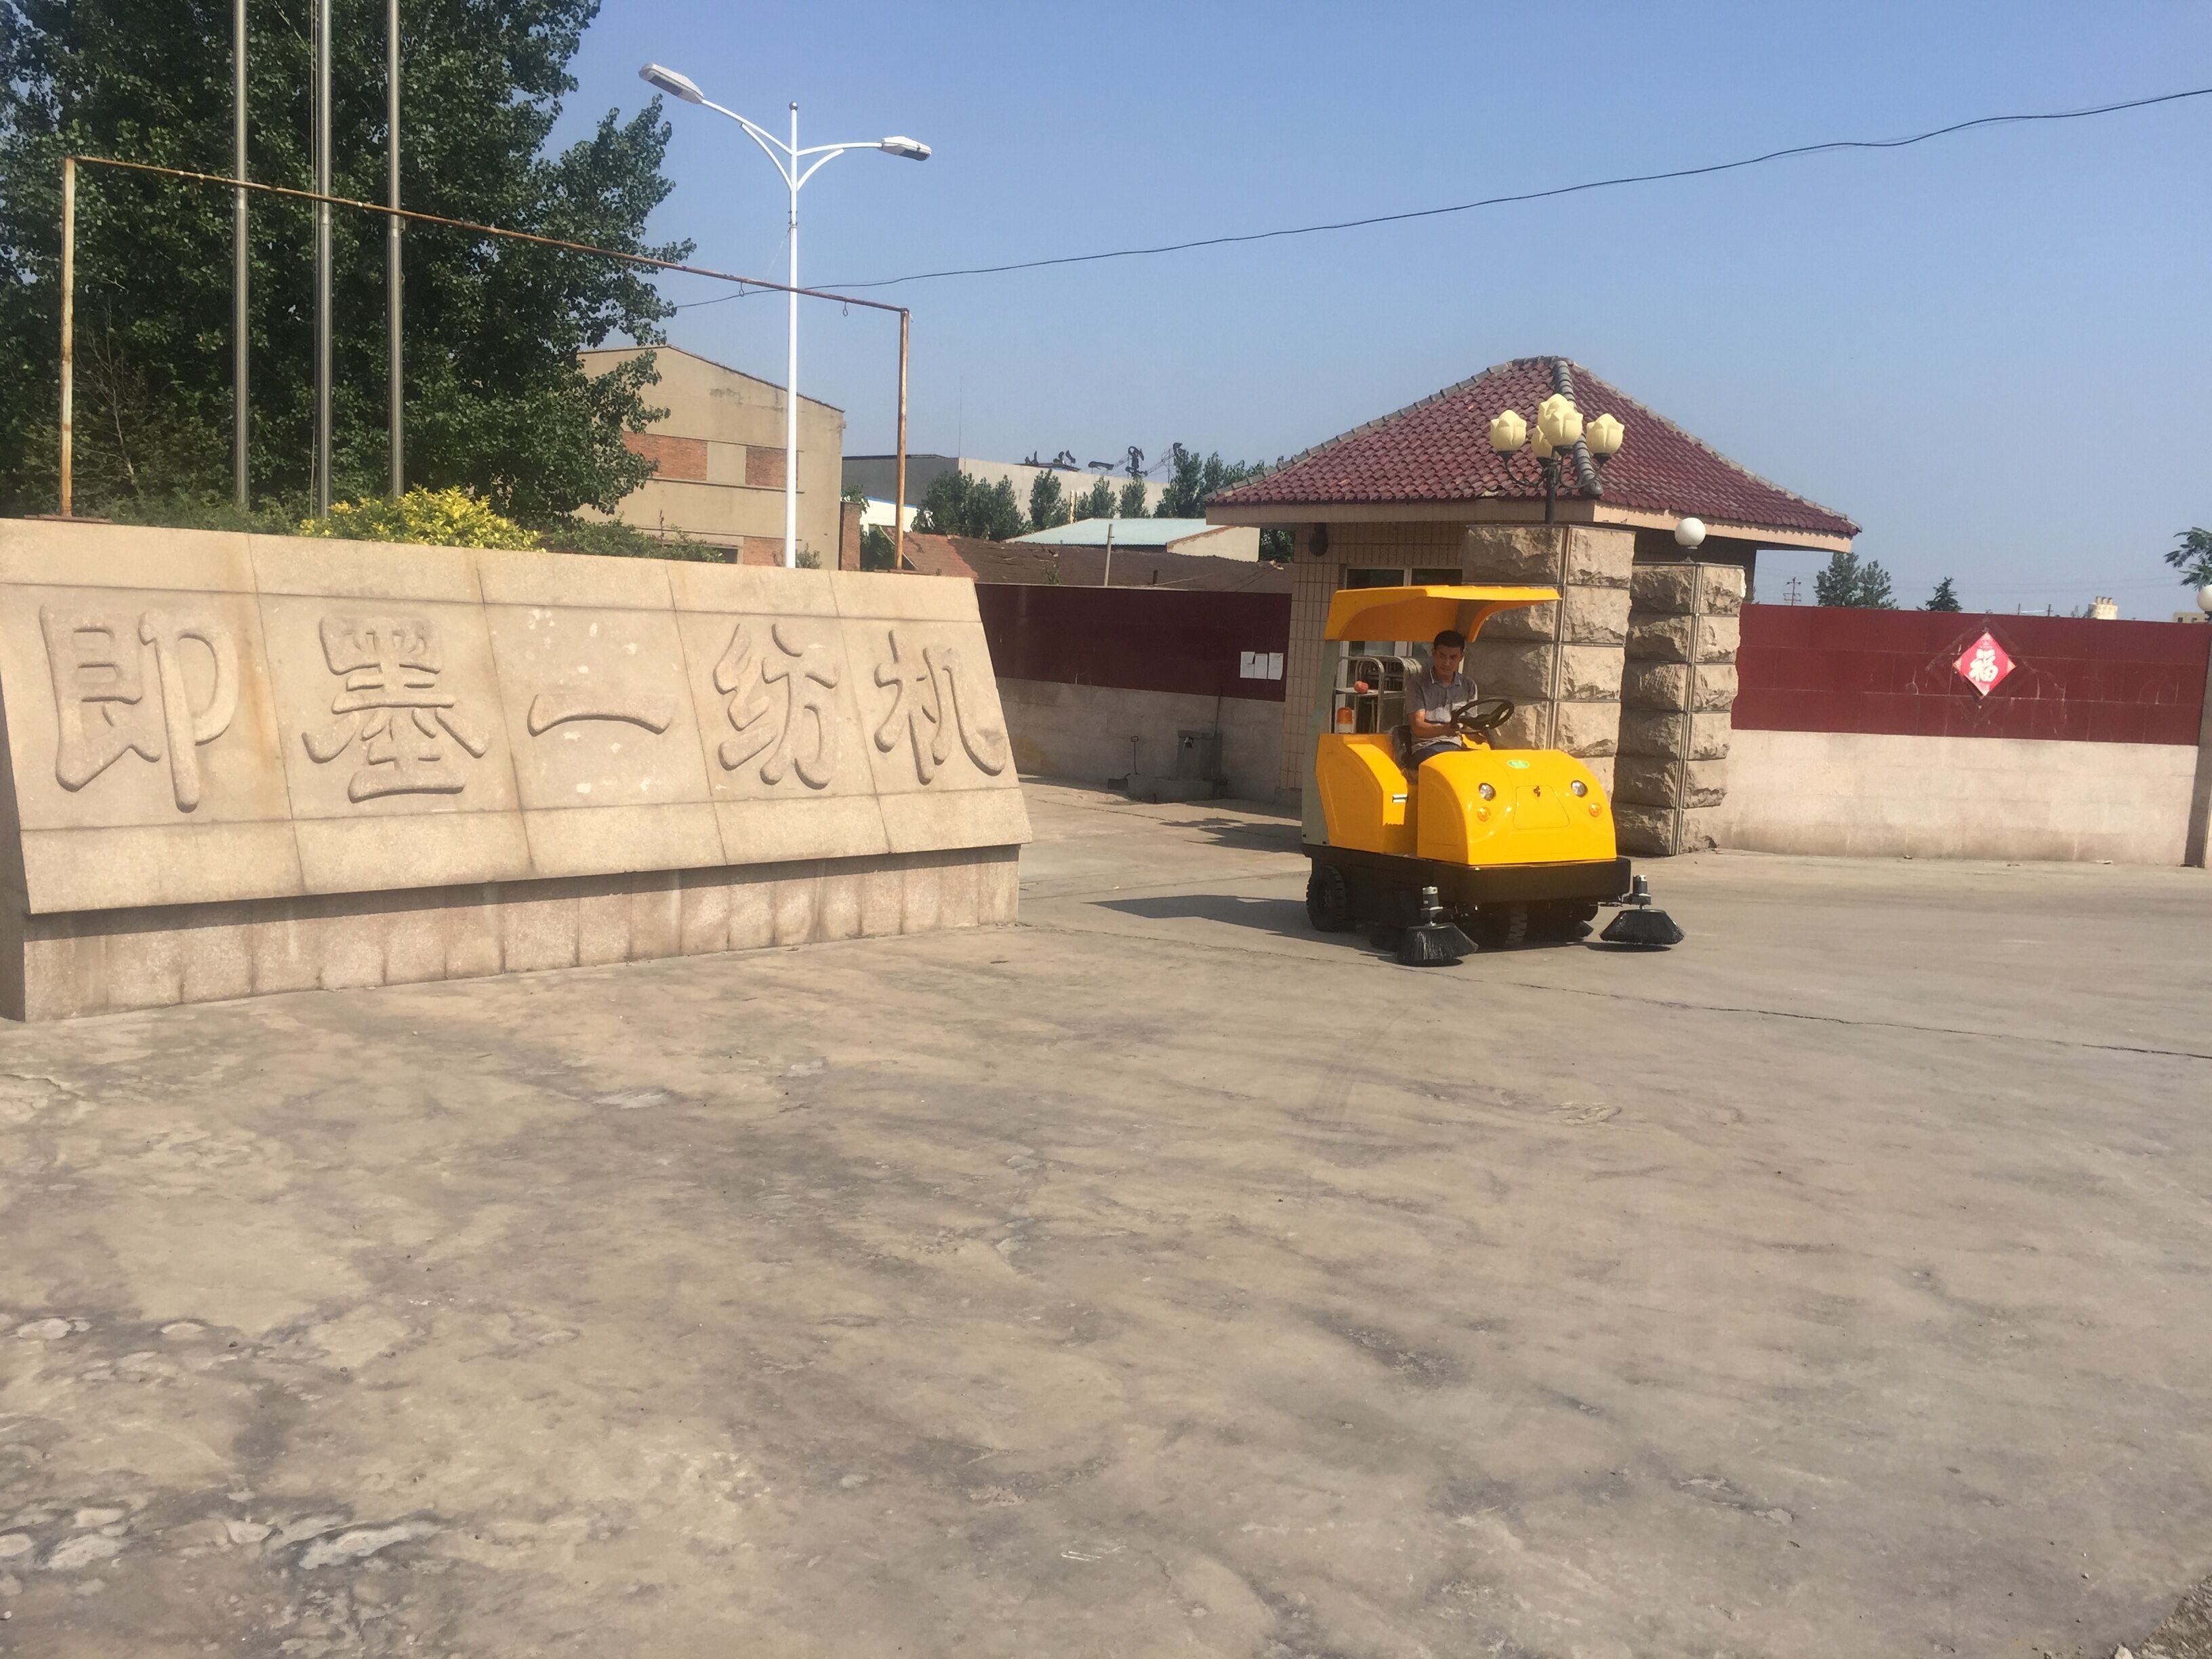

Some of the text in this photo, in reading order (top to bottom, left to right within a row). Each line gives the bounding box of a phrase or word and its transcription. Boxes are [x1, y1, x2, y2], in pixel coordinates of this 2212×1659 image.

[39, 605, 1007, 813] 即墨一纺机
[1969, 649, 1999, 682] 福
